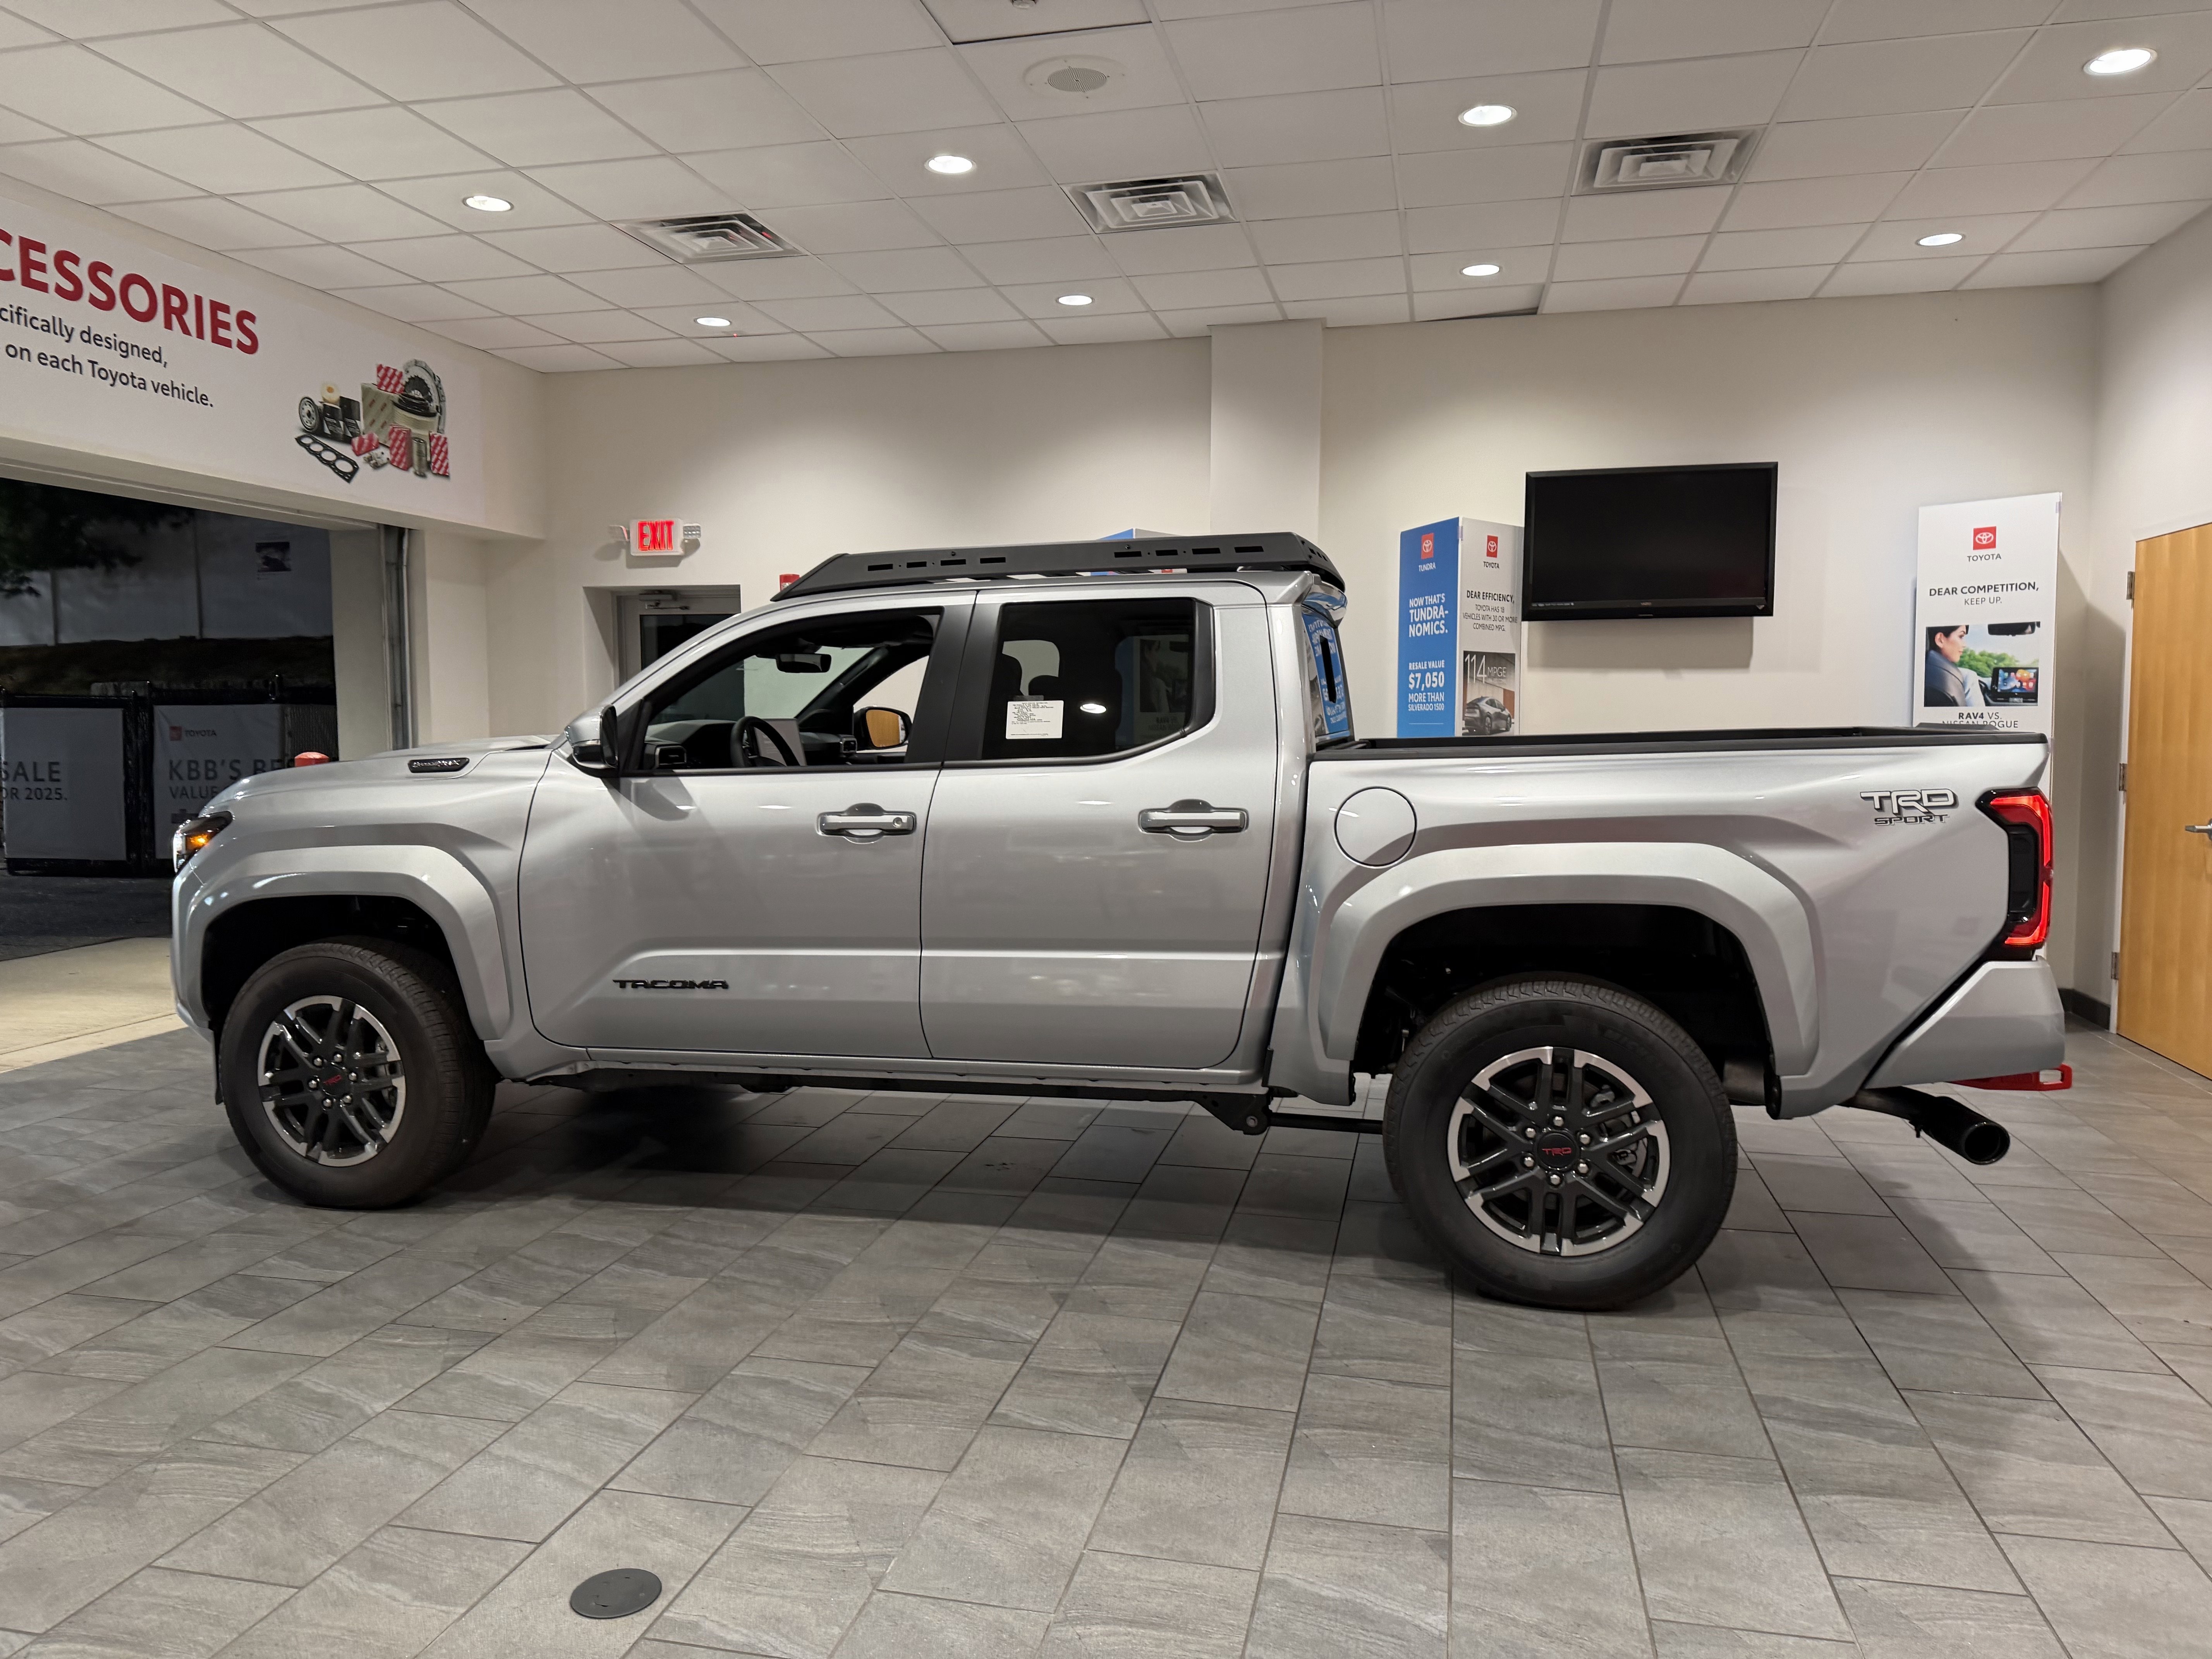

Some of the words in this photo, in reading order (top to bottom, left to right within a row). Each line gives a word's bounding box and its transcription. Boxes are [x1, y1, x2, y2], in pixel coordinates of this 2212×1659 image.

[0, 304, 74, 342] cifically
[80, 326, 168, 368] designed,
[6, 344, 31, 362] on
[38, 354, 82, 375] each
[88, 359, 146, 390] Toyota
[151, 380, 213, 407] vehicle.
[638, 520, 674, 551] EXIT
[1967, 553, 2001, 562] TOYOTA
[1419, 562, 1436, 572] TUNDRA
[1929, 587, 1958, 596] DEAR
[1961, 582, 2039, 594] COMPETITION,
[1409, 597, 1424, 608] NOW
[1425, 593, 1445, 605] THAT'S
[1467, 590, 1480, 599] DEAR
[1482, 592, 1515, 604] EFFICIENCY,
[1409, 605, 1448, 622] TUNDRA-
[1409, 620, 1448, 637] NOMICS.
[1409, 661, 1427, 670] RESALE
[1428, 660, 1445, 669] VALUE
[1465, 654, 1487, 684] 114
[1408, 671, 1444, 691] $7,050
[1408, 692, 1426, 702] MORE
[1427, 692, 1444, 702] THAN
[1408, 703, 1433, 711] SILVERADO
[169, 759, 242, 780] KBB'S
[25, 787, 67, 800] 2025.
[169, 786, 219, 799] VALUE
[1860, 788, 1956, 816] TRD
[1874, 814, 1949, 826] SPORT
[613, 979, 729, 989] TACOMA
[1542, 1147, 1572, 1156] TRD
